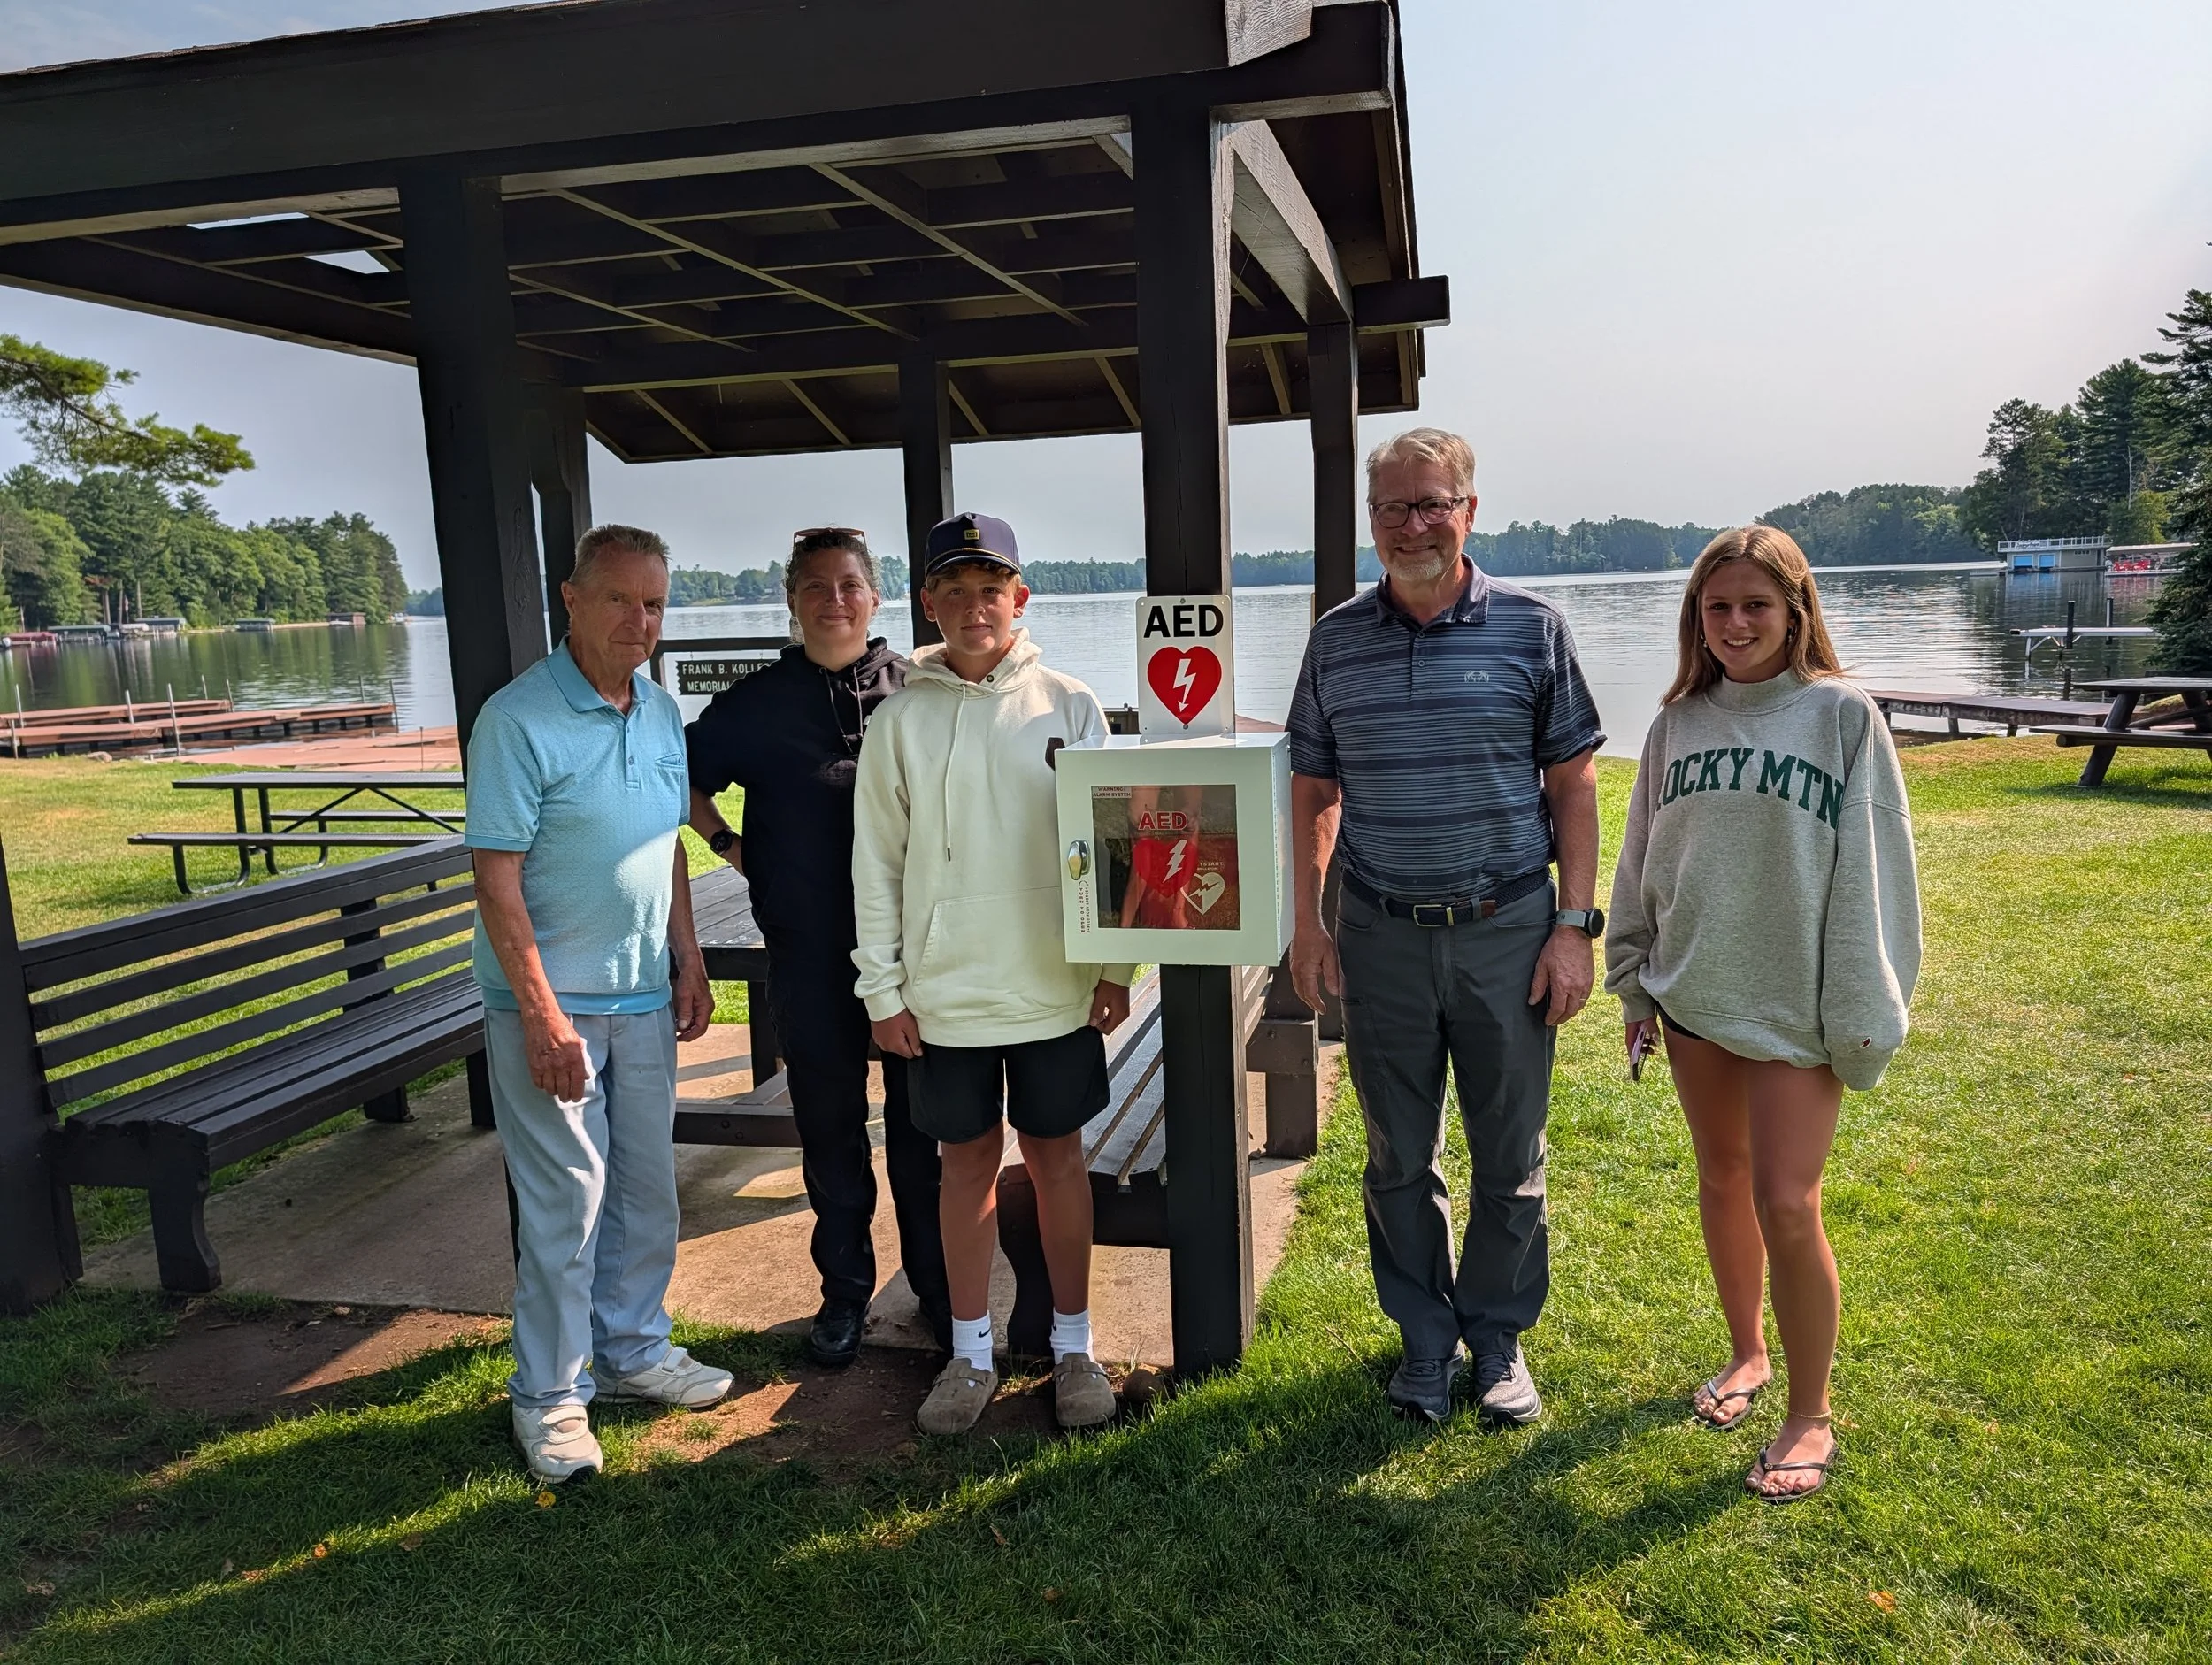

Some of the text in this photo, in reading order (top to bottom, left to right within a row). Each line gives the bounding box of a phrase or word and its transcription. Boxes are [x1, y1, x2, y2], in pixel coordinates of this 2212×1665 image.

[1143, 605, 1224, 638] AED
[682, 663, 771, 675] FRANK B. KOLLE
[687, 681, 730, 692] MEMORIAL
[1656, 748, 1844, 830] OCKY MTN
[1138, 810, 1187, 831] AED
[1079, 906, 1085, 915] TO
